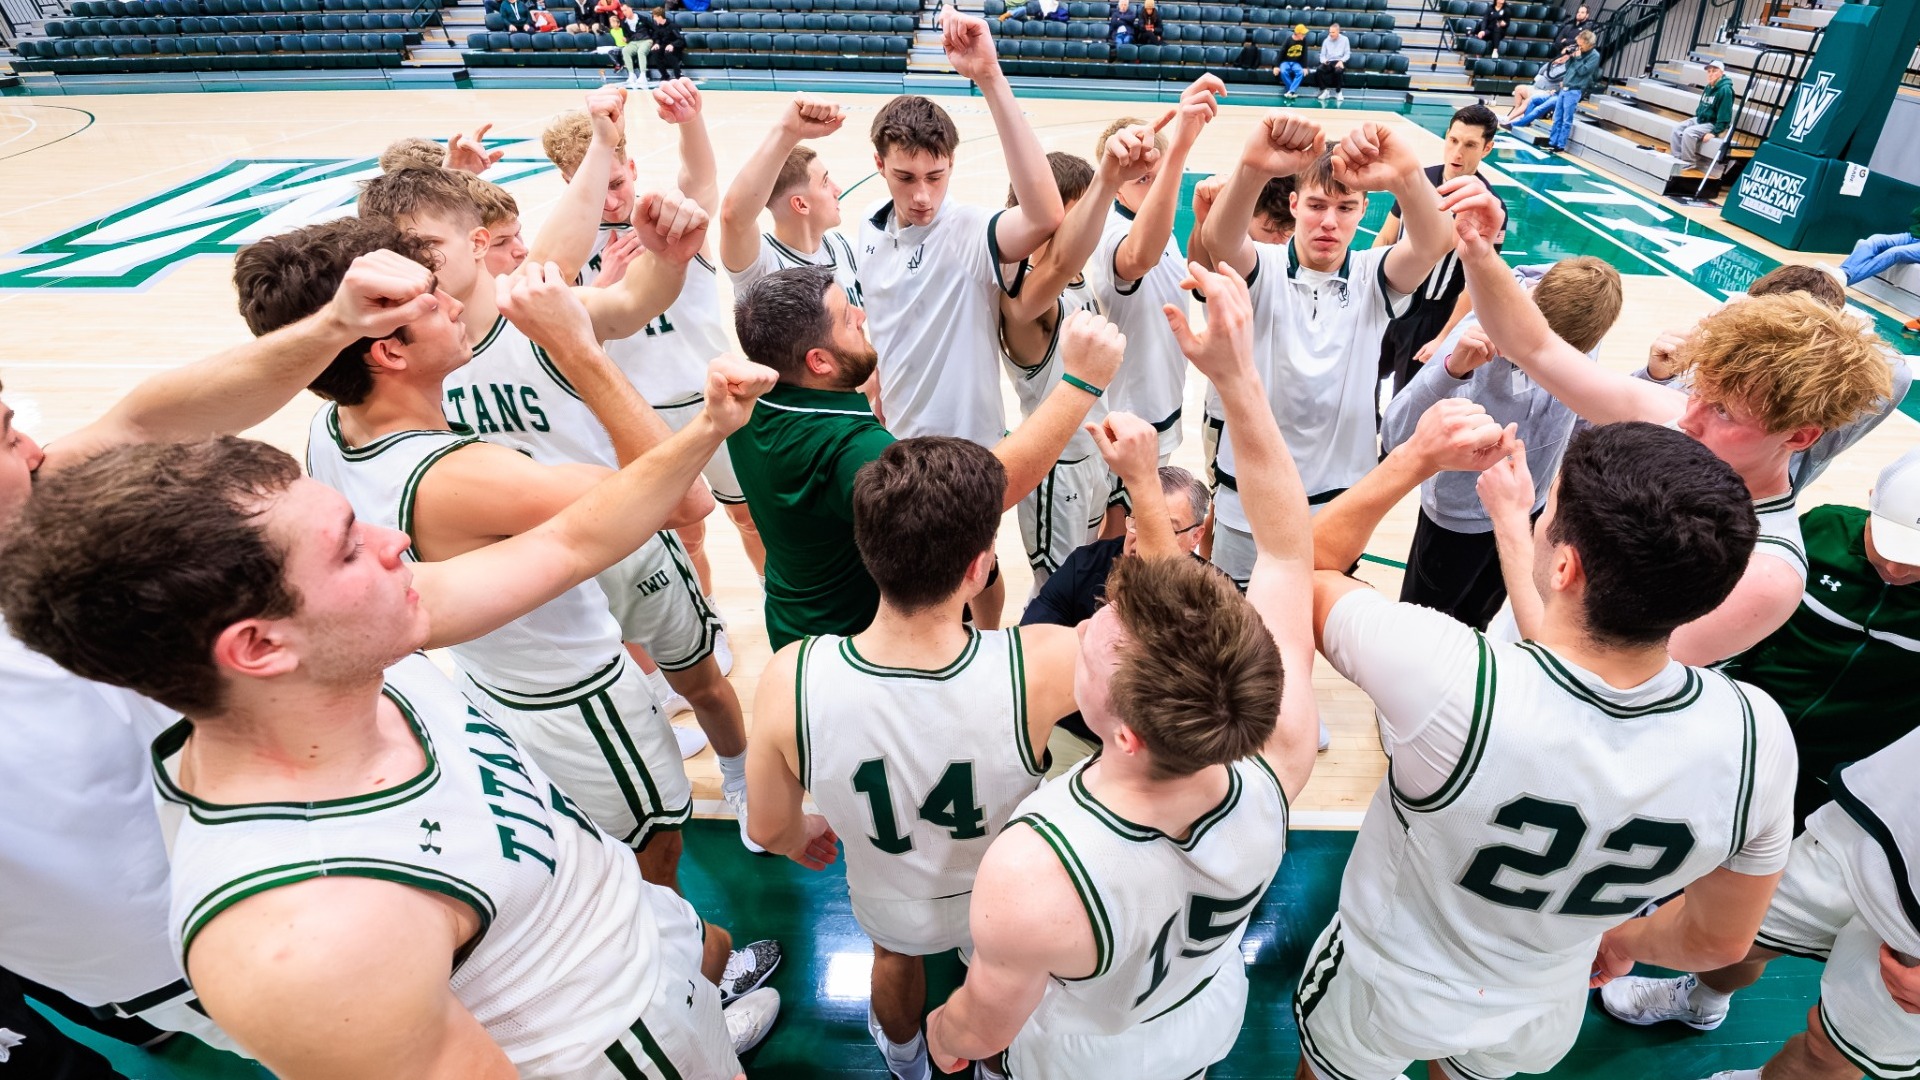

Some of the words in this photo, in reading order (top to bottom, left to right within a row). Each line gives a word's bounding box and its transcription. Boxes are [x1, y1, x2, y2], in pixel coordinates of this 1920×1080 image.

[1741, 179, 1798, 212] WESLEYAN
[1751, 166, 1800, 194] ILLINOIS
[1747, 199, 1779, 216] TITANS
[447, 383, 550, 433] TANS
[637, 570, 670, 597] IWU
[463, 696, 558, 877] TITAN
[850, 755, 990, 856] 14
[1454, 792, 1699, 918] 22
[1131, 879, 1266, 1010] 15
